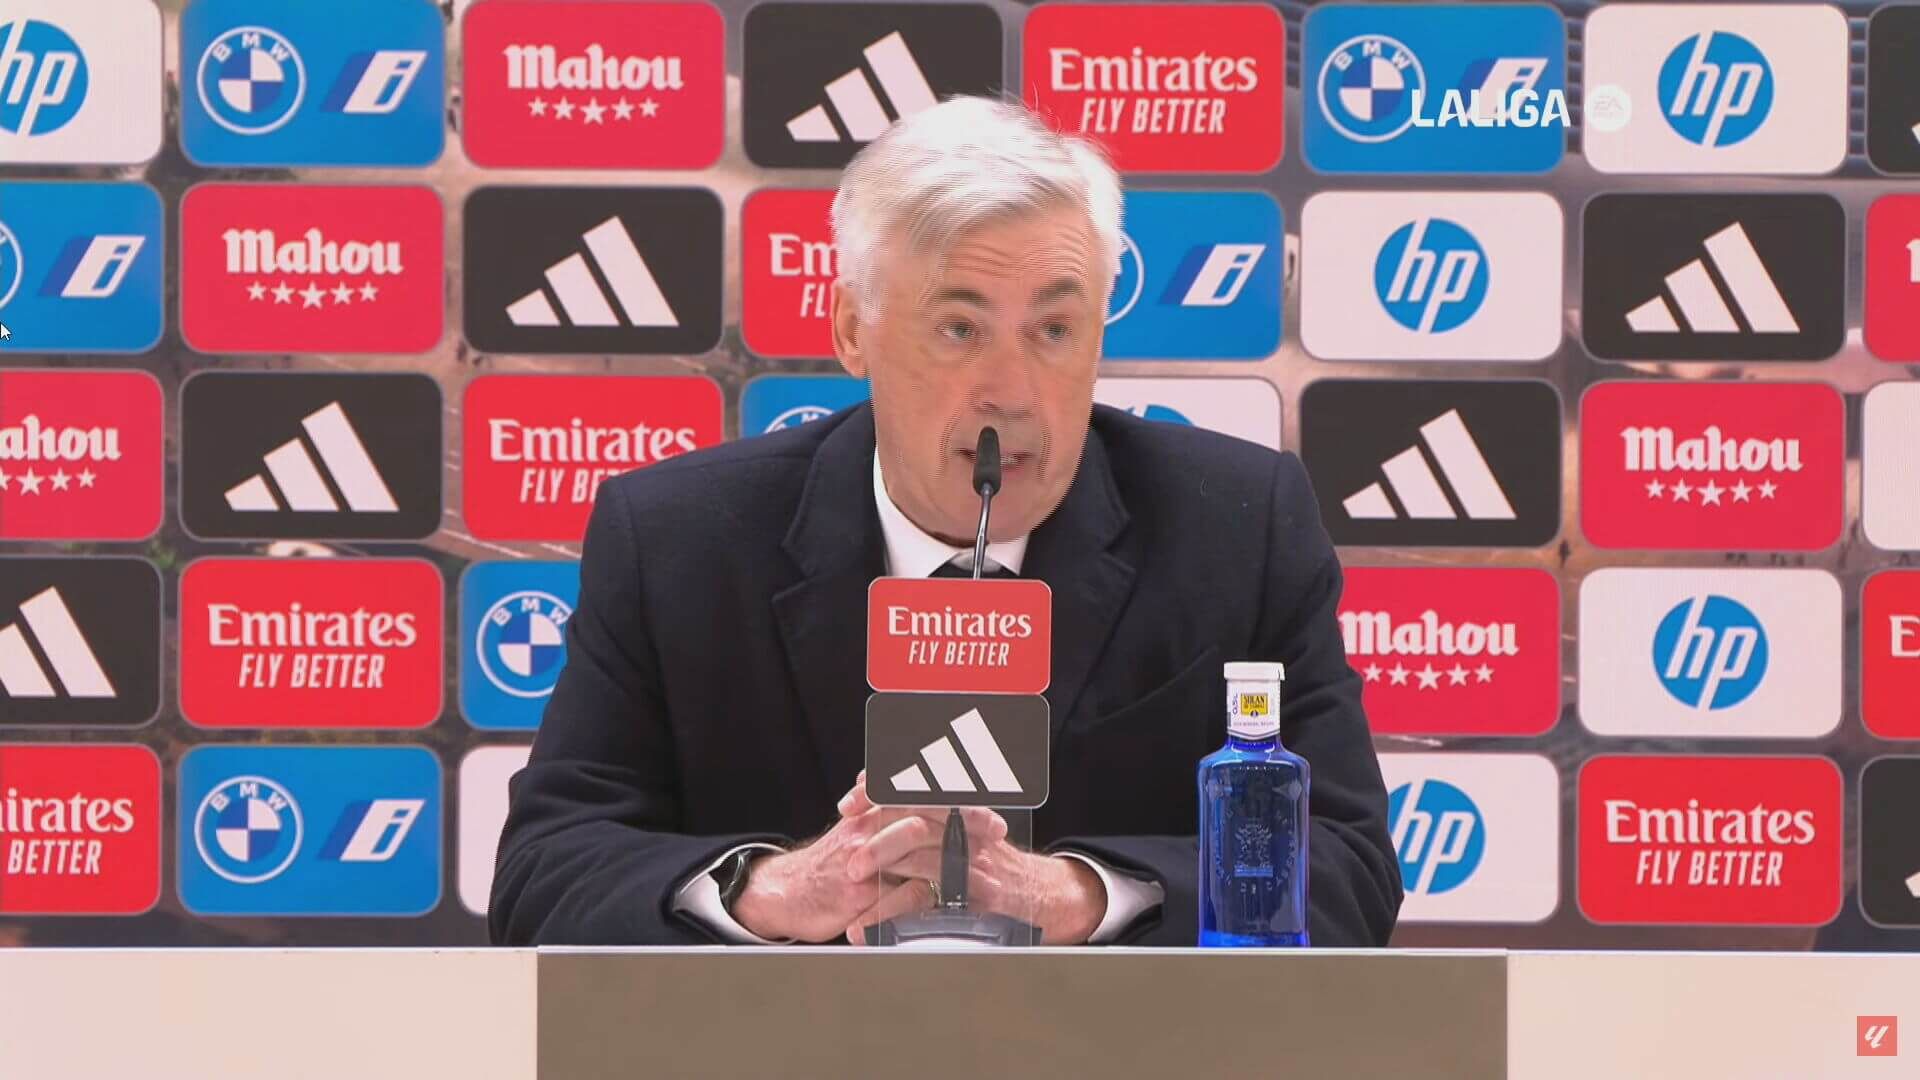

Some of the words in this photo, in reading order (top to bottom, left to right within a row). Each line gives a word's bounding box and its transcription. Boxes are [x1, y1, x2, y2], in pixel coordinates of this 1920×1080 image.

[211, 31, 290, 64] BMW
[503, 43, 684, 91] Mahou
[1050, 47, 1258, 92] Emirates
[1333, 40, 1412, 71] BMW
[0, 20, 79, 137] hp
[1669, 31, 1764, 148] hp
[1080, 98, 1125, 133] FLY
[1132, 98, 1226, 133] BETTER
[222, 228, 403, 275] Mahou
[1385, 218, 1480, 334] hp
[799, 282, 826, 318] FL
[0, 414, 121, 461] ahou
[489, 418, 697, 462] Emirates
[1621, 425, 1803, 472] Mahou
[520, 468, 565, 503] FLY
[207, 602, 417, 647] Emirates
[490, 597, 570, 627] BMW
[887, 605, 1032, 638] Emirates
[1338, 609, 1519, 656] Mahou
[239, 653, 284, 688] FLY
[291, 653, 385, 689] BETTER
[908, 640, 940, 665] FLY
[944, 641, 1010, 667] BETTER
[1663, 596, 1758, 710] hp
[0, 788, 134, 833] irates
[208, 781, 287, 813] BMW
[1391, 779, 1476, 894] hp
[1605, 799, 1815, 845] Emirates
[7, 839, 102, 874] BETTER
[1636, 850, 1681, 885] FLY
[1688, 850, 1783, 886] BETTER
